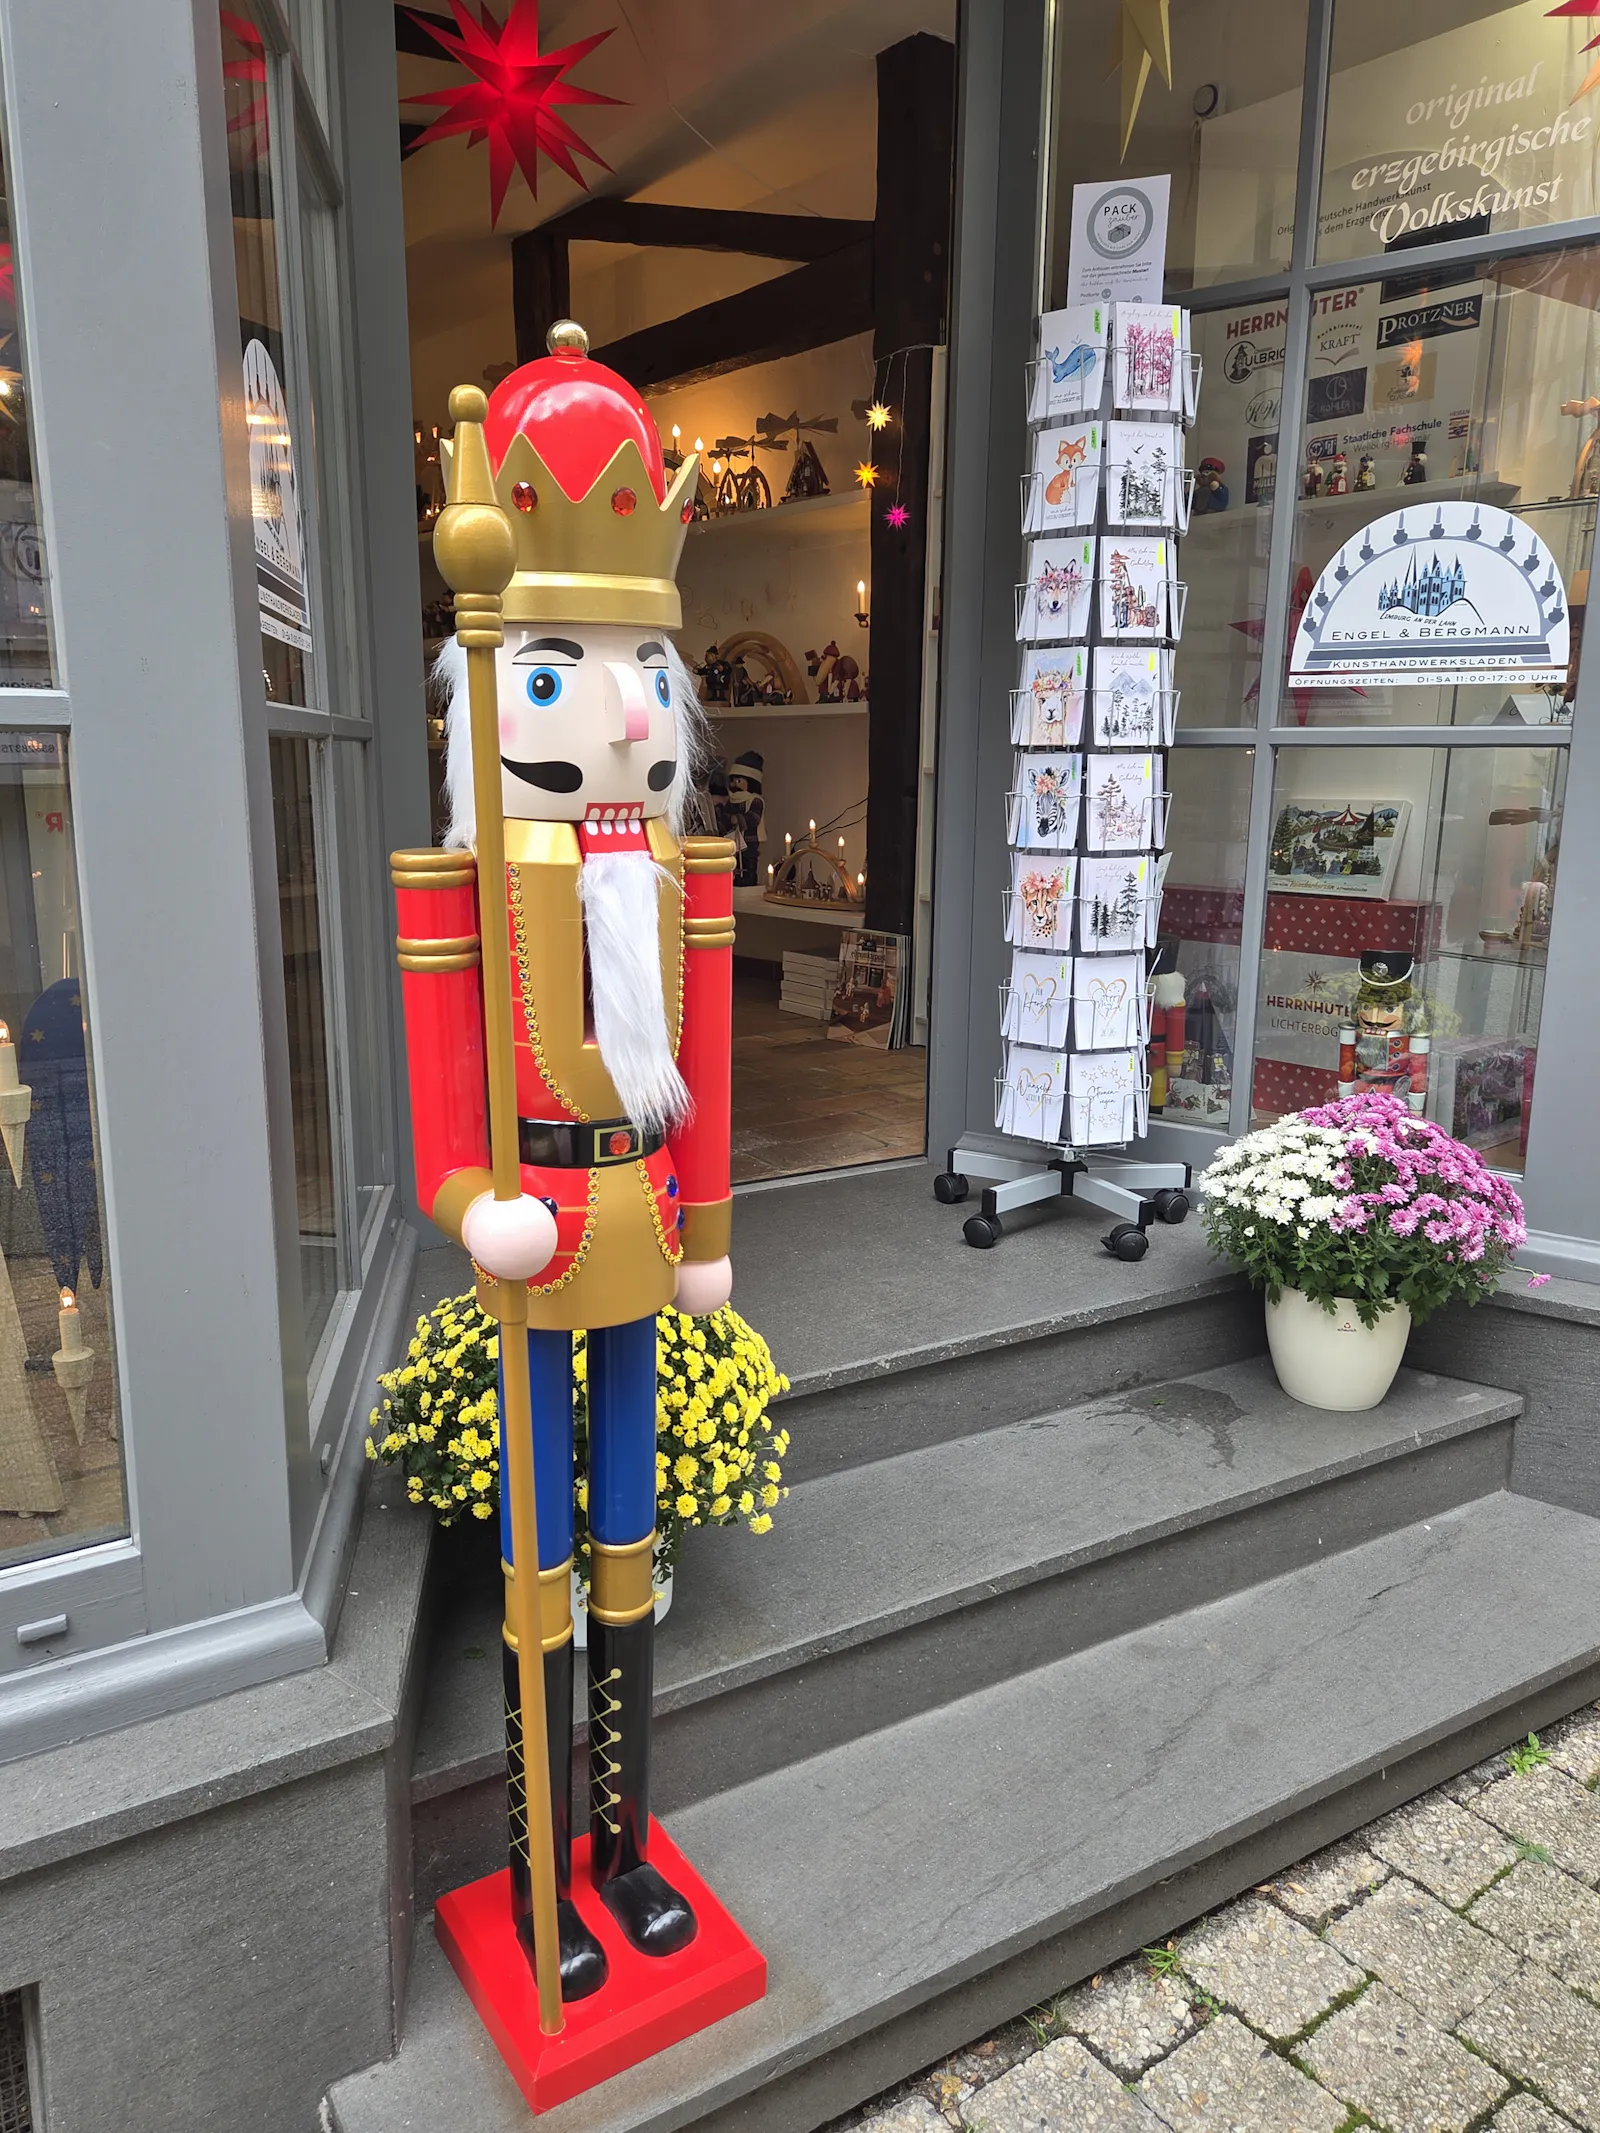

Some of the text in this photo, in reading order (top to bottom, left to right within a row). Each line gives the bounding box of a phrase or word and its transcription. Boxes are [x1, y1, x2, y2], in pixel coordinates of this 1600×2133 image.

[1406, 61, 1544, 130] original
[1351, 111, 1592, 194] erzgebirgische
[1103, 203, 1137, 216] PACK
[1317, 206, 1353, 223] eutsche
[1355, 183, 1432, 213] Handwerkskunst
[1369, 172, 1564, 244] Volkskunst
[1324, 220, 1344, 235] dem
[1378, 300, 1476, 344] PROTZNER
[1320, 333, 1361, 351] KRAFT
[1245, 348, 1286, 367] ULBRIC
[1343, 419, 1443, 445] Staatliche Fachschule
[1331, 625, 1530, 641] ENGEL & BERGMANN
[1333, 657, 1517, 669] KUNSTHANDWERKSLADEN
[1294, 674, 1558, 686] ÖFFNUNGSZEITEN: DI-SA 11:00-17:00 UHR
[1271, 1018, 1339, 1038] LICHTERBOG
